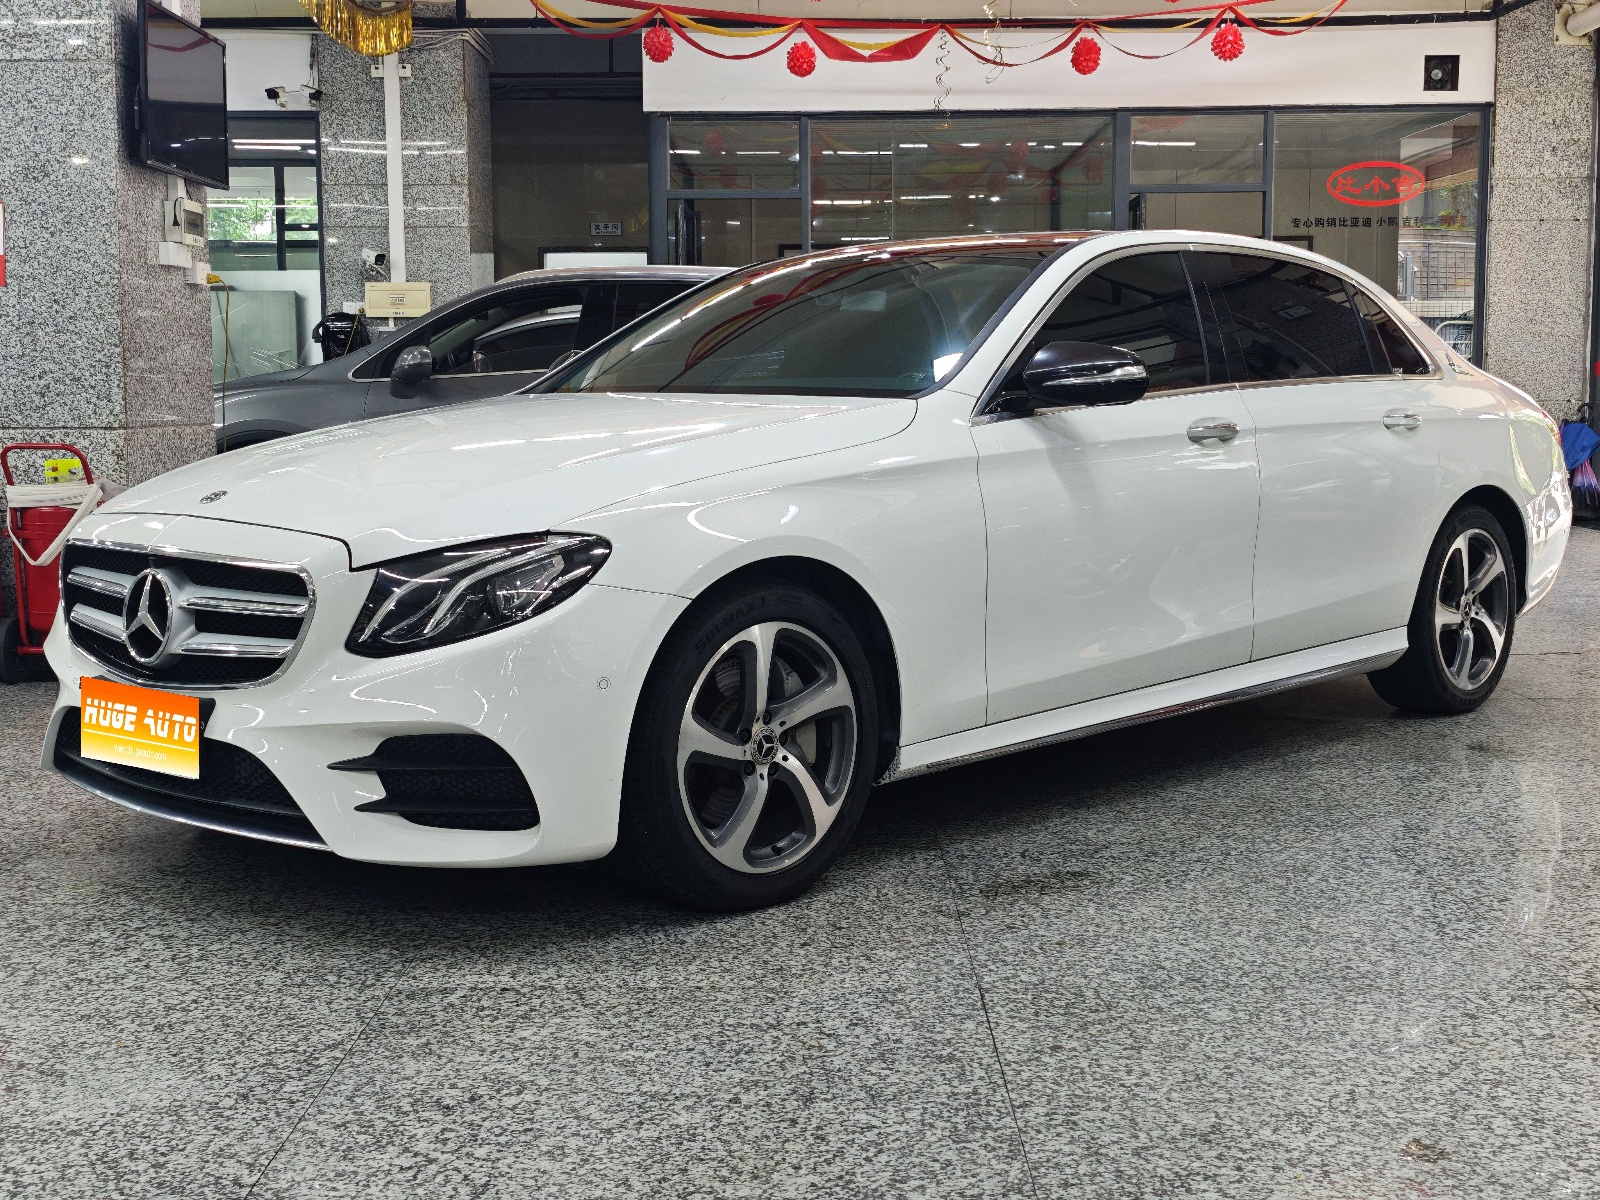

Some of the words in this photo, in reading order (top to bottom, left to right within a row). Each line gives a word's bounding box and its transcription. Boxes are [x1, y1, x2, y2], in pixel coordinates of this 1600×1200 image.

[1335, 175, 1418, 194] 比小吉
[1291, 217, 1372, 228] 专心购销比亚迪
